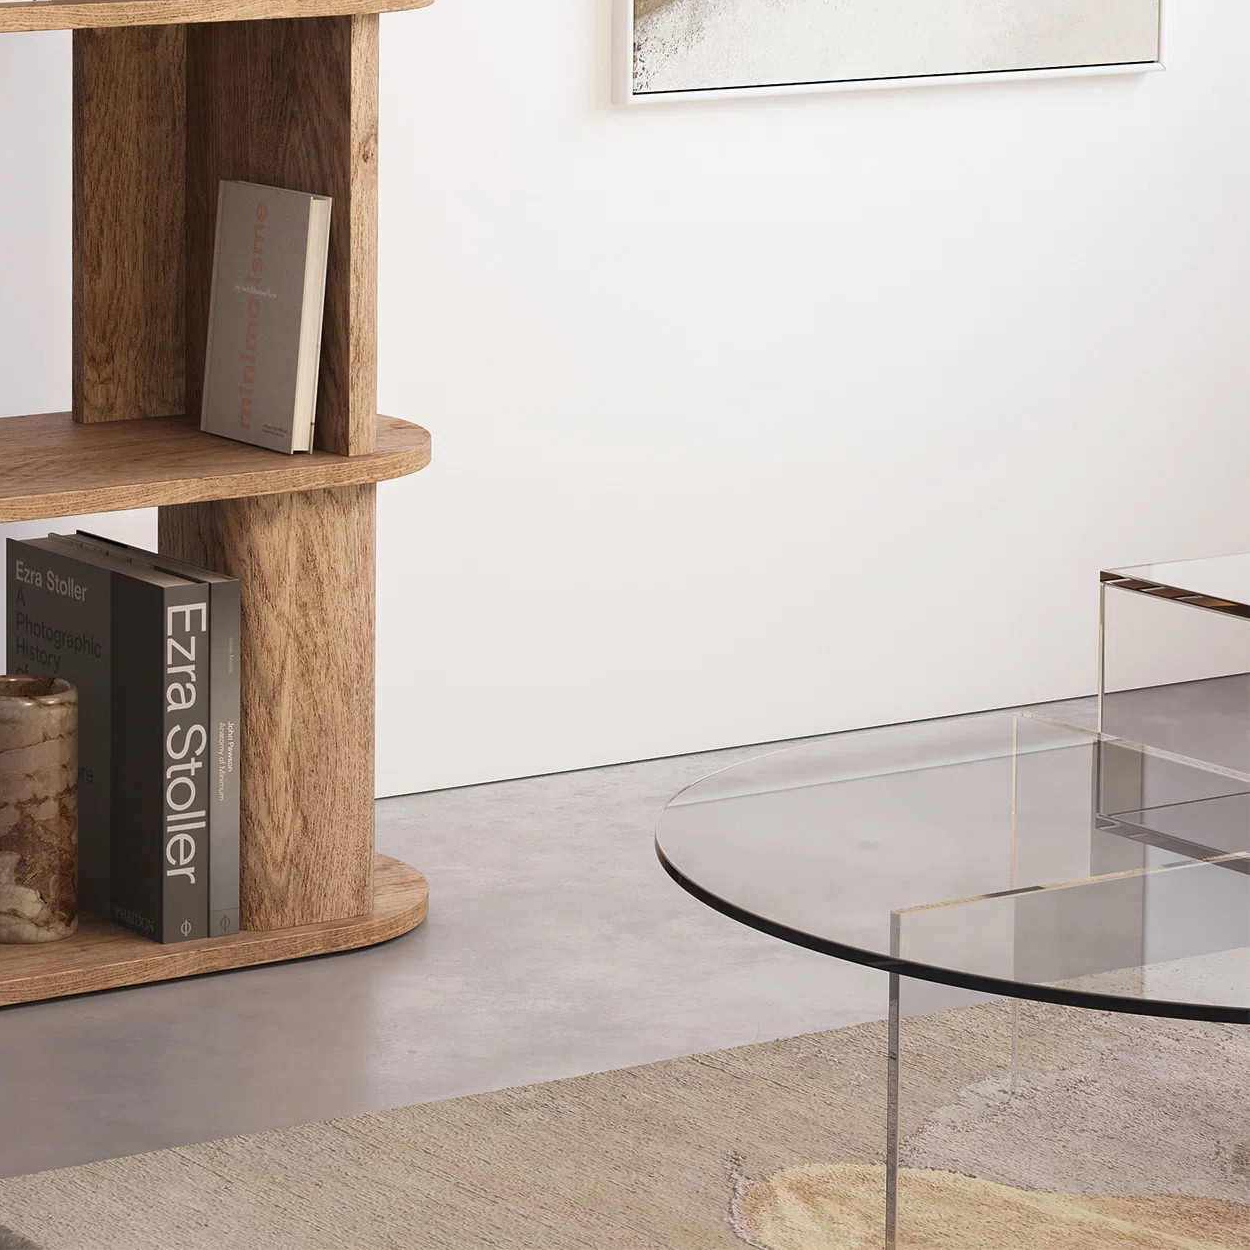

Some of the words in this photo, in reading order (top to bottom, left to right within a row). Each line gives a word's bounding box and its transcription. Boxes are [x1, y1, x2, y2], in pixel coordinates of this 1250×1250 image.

[15, 559, 43, 588] Ezra
[46, 570, 88, 602] Stoller
[16, 587, 26, 608] A
[16, 611, 103, 659] Photographic
[16, 636, 61, 674] History
[167, 601, 207, 713] Ezra
[218, 722, 226, 755] Anatomy
[227, 742, 235, 772] Pawson
[219, 756, 226, 764] of
[166, 724, 207, 884] Stoller
